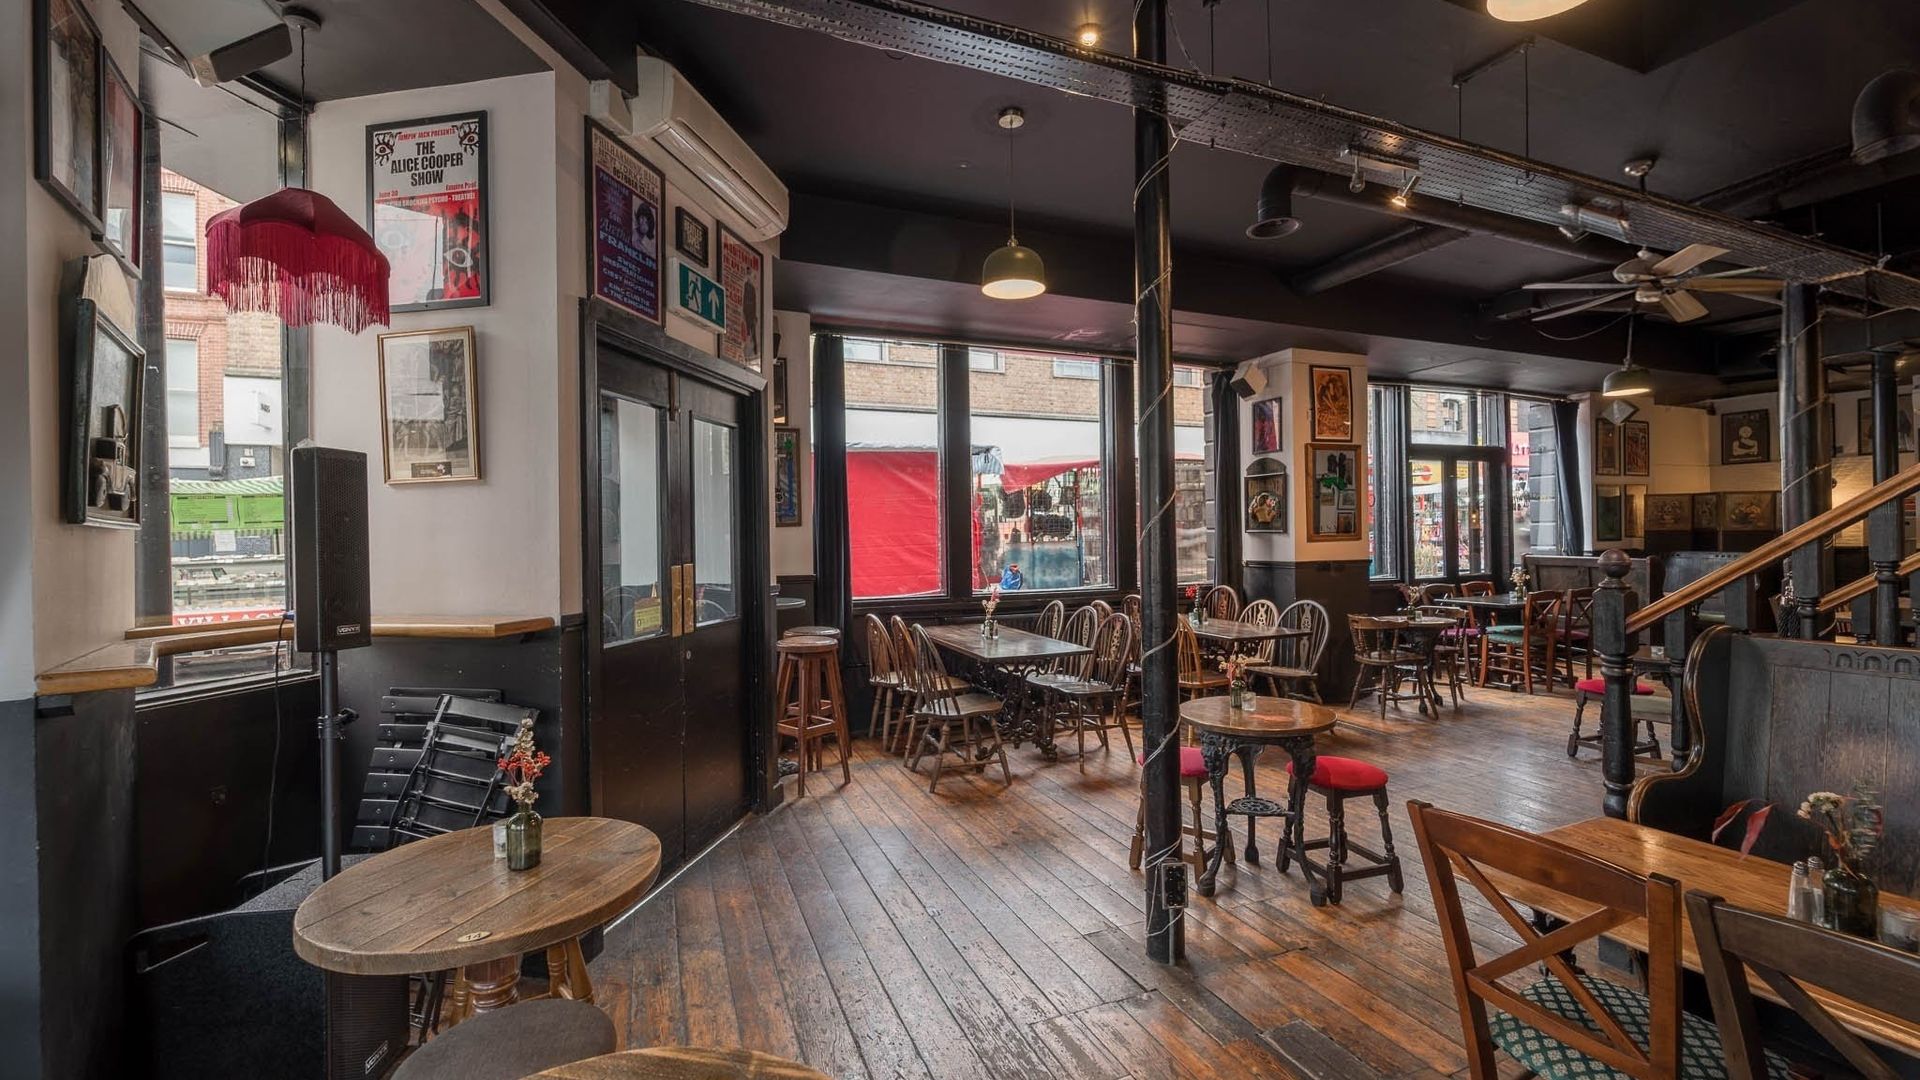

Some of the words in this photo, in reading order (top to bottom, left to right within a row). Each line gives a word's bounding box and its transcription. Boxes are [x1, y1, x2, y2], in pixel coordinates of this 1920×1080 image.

[415, 140, 435, 156] THE
[391, 157, 420, 174] ALICE
[421, 152, 463, 170] COOPER
[410, 169, 443, 187] SHOW
[600, 230, 656, 271] FRANKLIN
